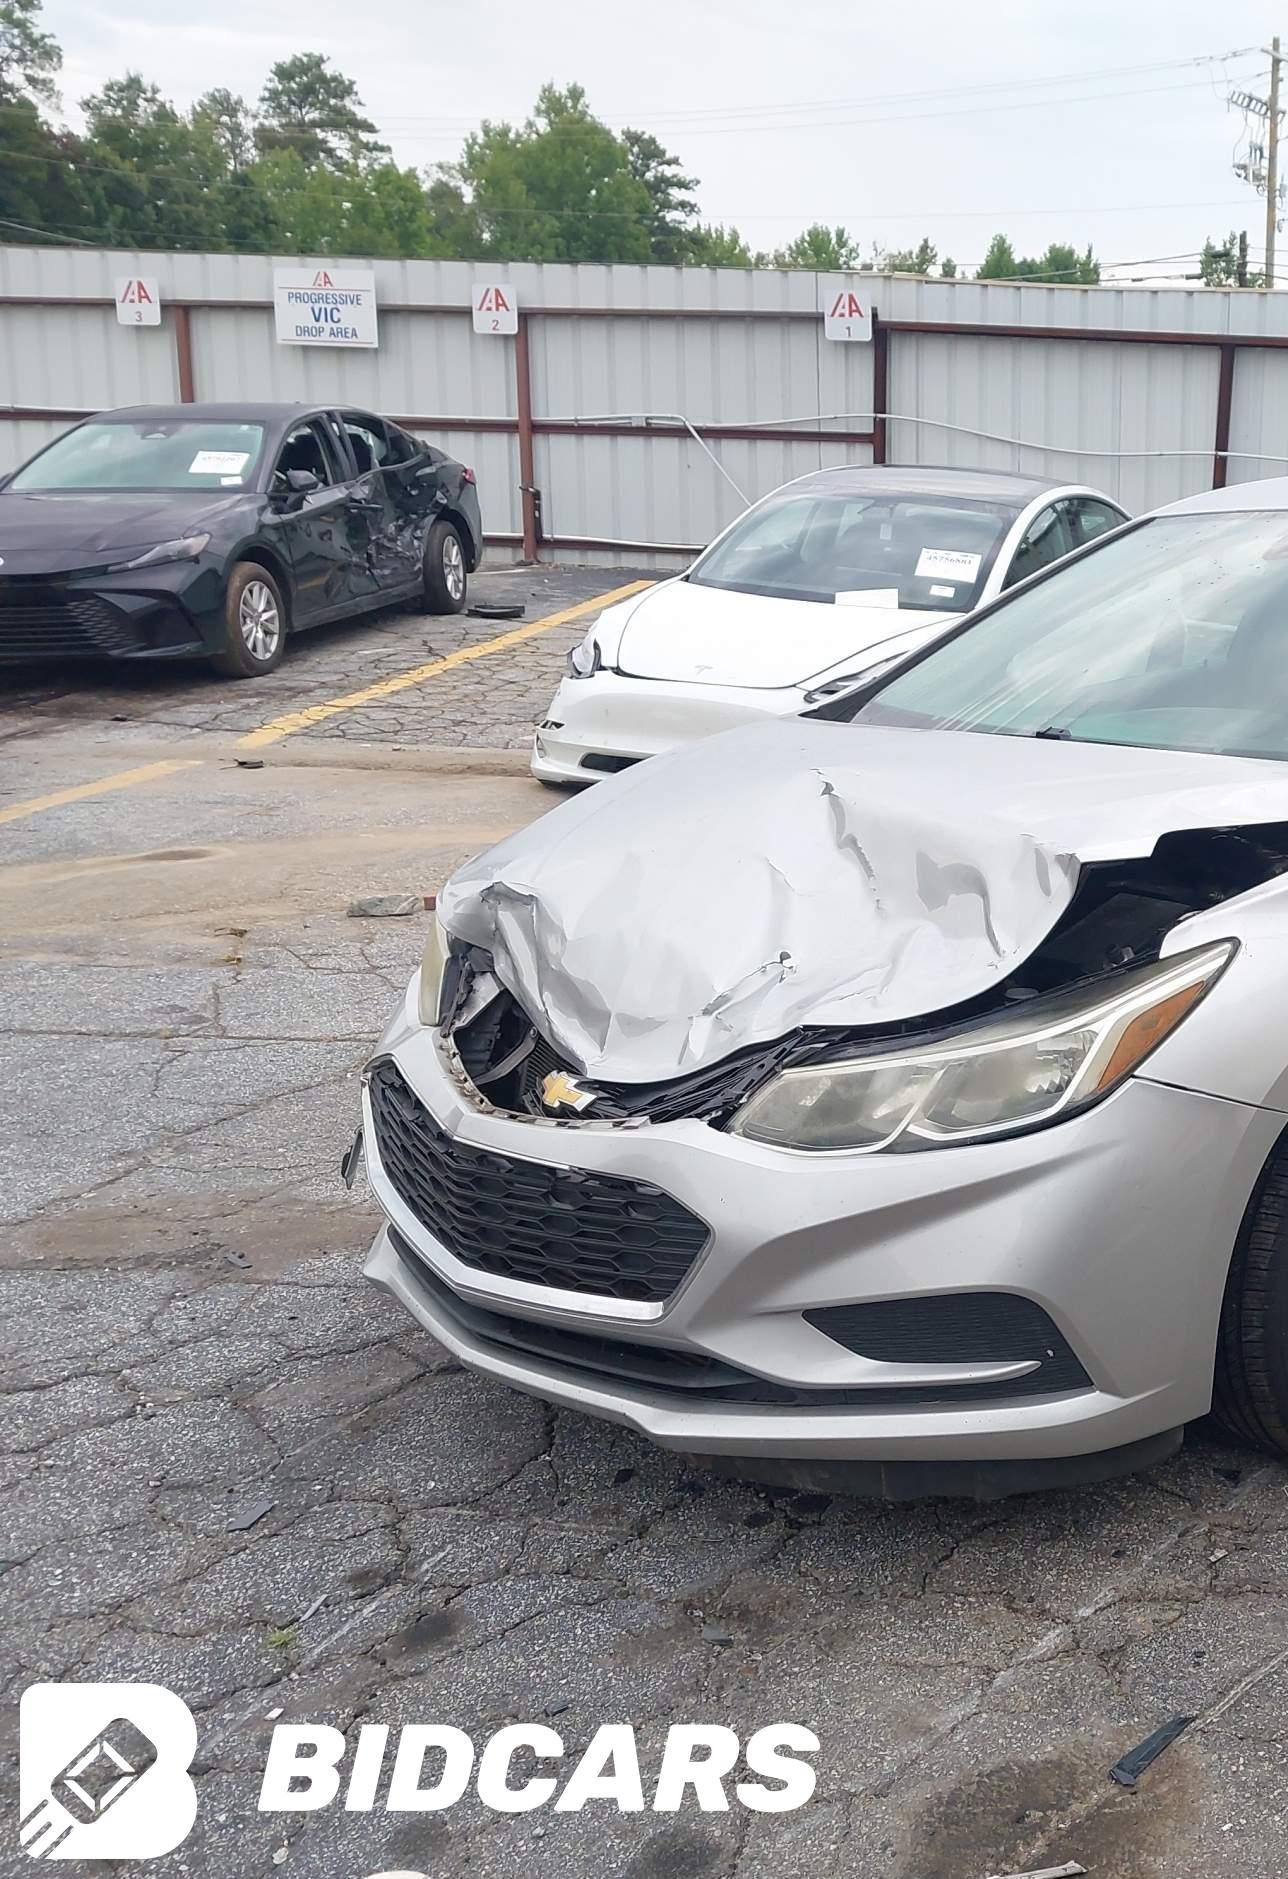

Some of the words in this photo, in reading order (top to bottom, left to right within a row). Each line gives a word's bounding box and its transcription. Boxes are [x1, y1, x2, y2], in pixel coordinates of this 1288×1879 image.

[287, 291, 362, 305] PROGRESSIVE
[135, 311, 143, 322] 3
[310, 306, 342, 324] VIC
[491, 319, 499, 331] 2
[295, 325, 325, 338] DROP
[328, 327, 359, 339] AREA
[845, 326, 851, 338] 1
